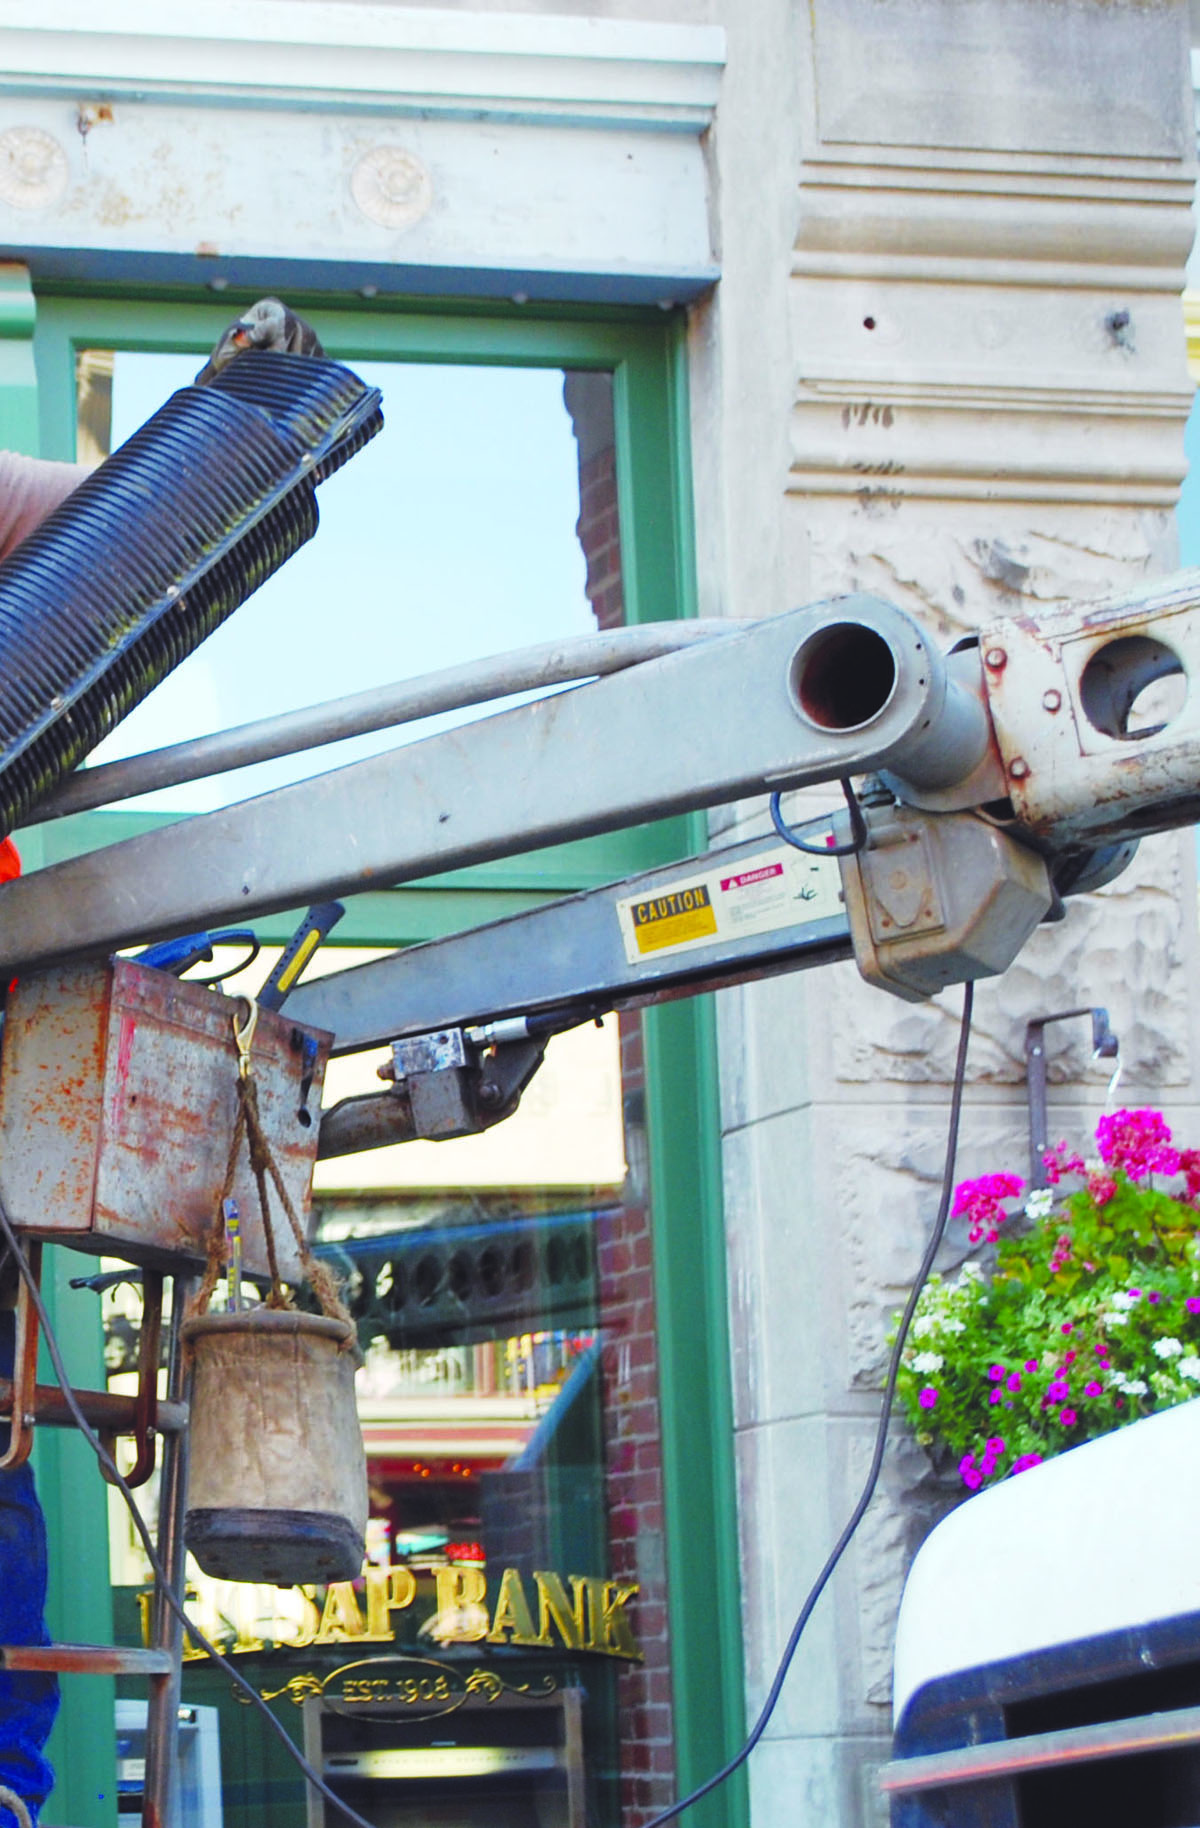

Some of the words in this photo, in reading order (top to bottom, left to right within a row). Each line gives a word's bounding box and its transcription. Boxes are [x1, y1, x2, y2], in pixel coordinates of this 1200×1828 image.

[739, 866, 777, 886] DANGER
[637, 889, 705, 924] CAUTION
[432, 1566, 645, 1664] BANK
[396, 1675, 450, 1704] 1908
